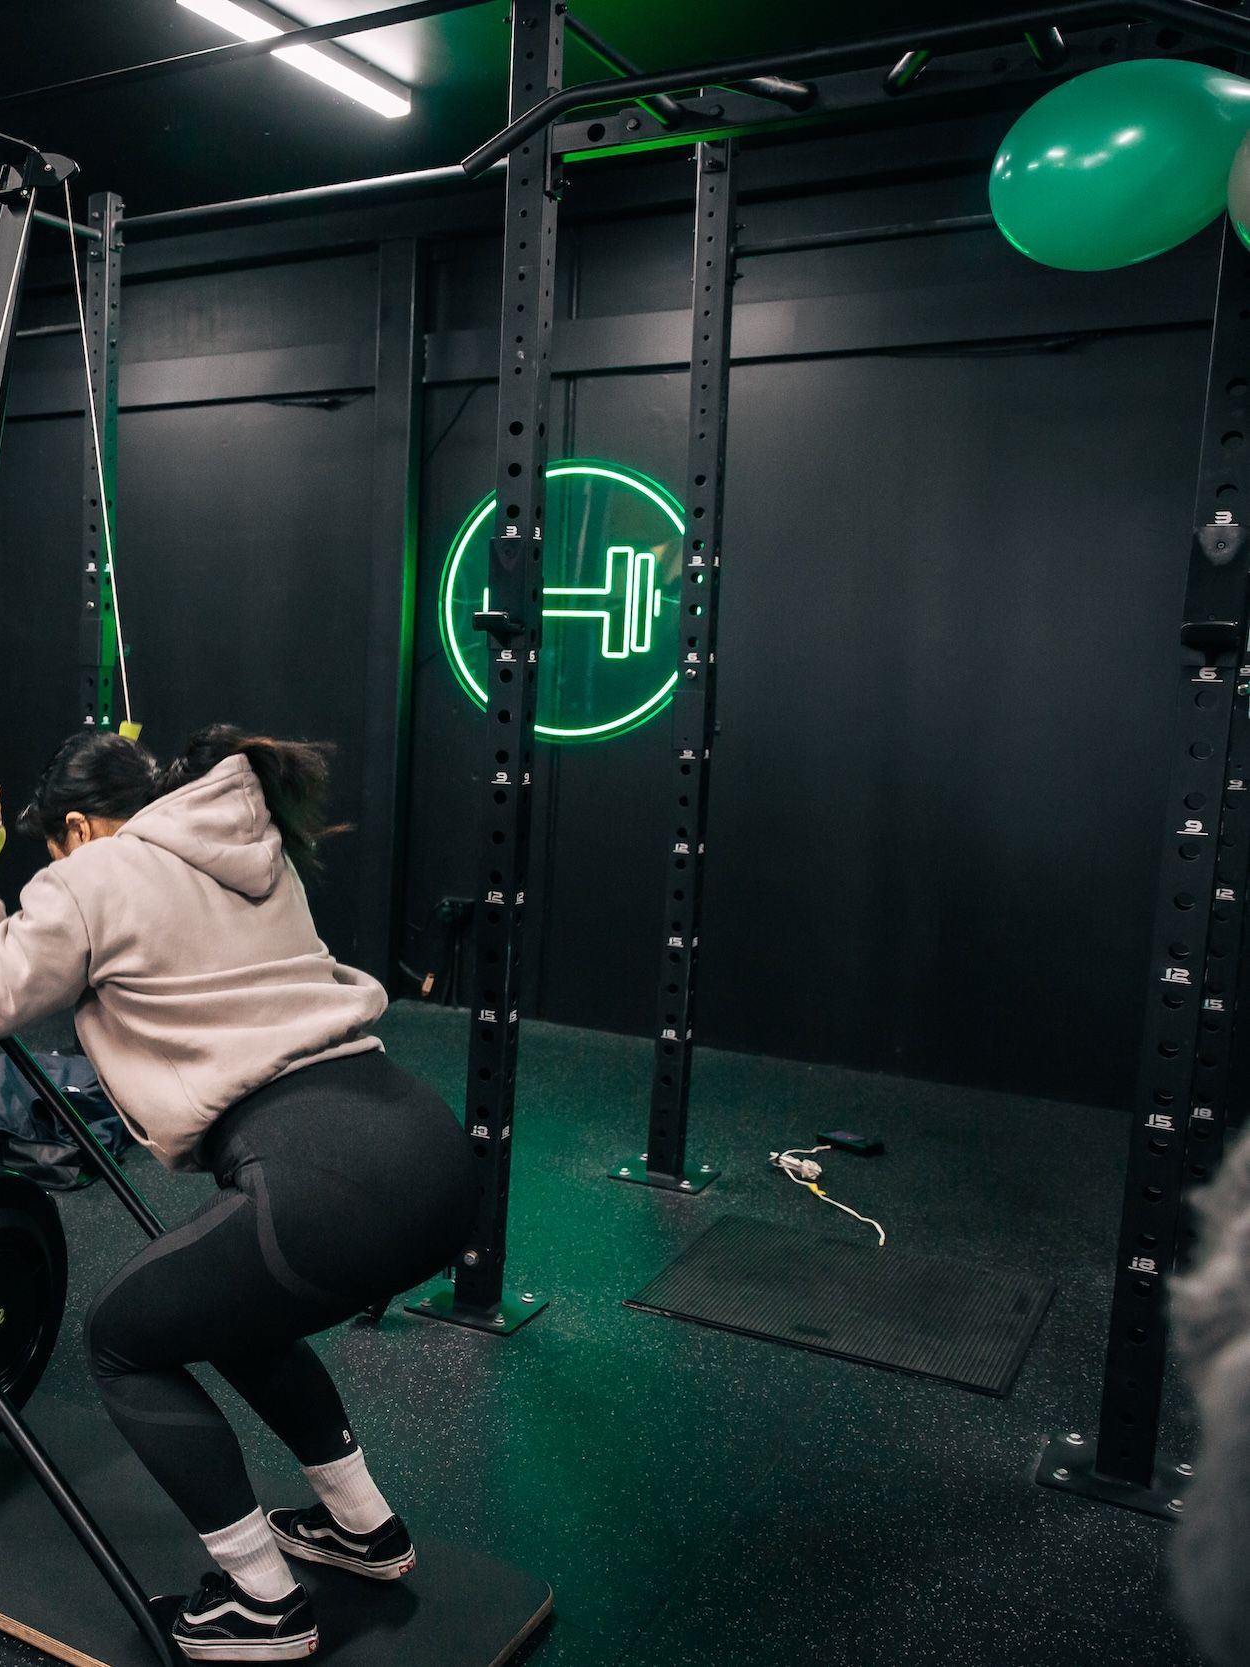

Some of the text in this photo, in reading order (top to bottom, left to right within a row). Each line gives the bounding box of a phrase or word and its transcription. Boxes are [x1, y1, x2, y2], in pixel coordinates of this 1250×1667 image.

[1214, 510, 1233, 524] 3
[505, 525, 518, 537] 3
[534, 526, 541, 538] 3
[501, 650, 513, 660] 6
[529, 650, 535, 661] 6
[1199, 666, 1218, 680] 6
[495, 771, 508, 782] 9
[523, 772, 530, 782] 9
[1229, 778, 1243, 789] 9
[1184, 819, 1203, 833] 9
[487, 890, 504, 902] 12
[1215, 888, 1235, 900] 12
[1165, 967, 1191, 981] 12
[1203, 998, 1224, 1010] 15
[480, 1009, 496, 1021] 15
[1193, 1107, 1212, 1118] 18
[1148, 1113, 1173, 1129] 15
